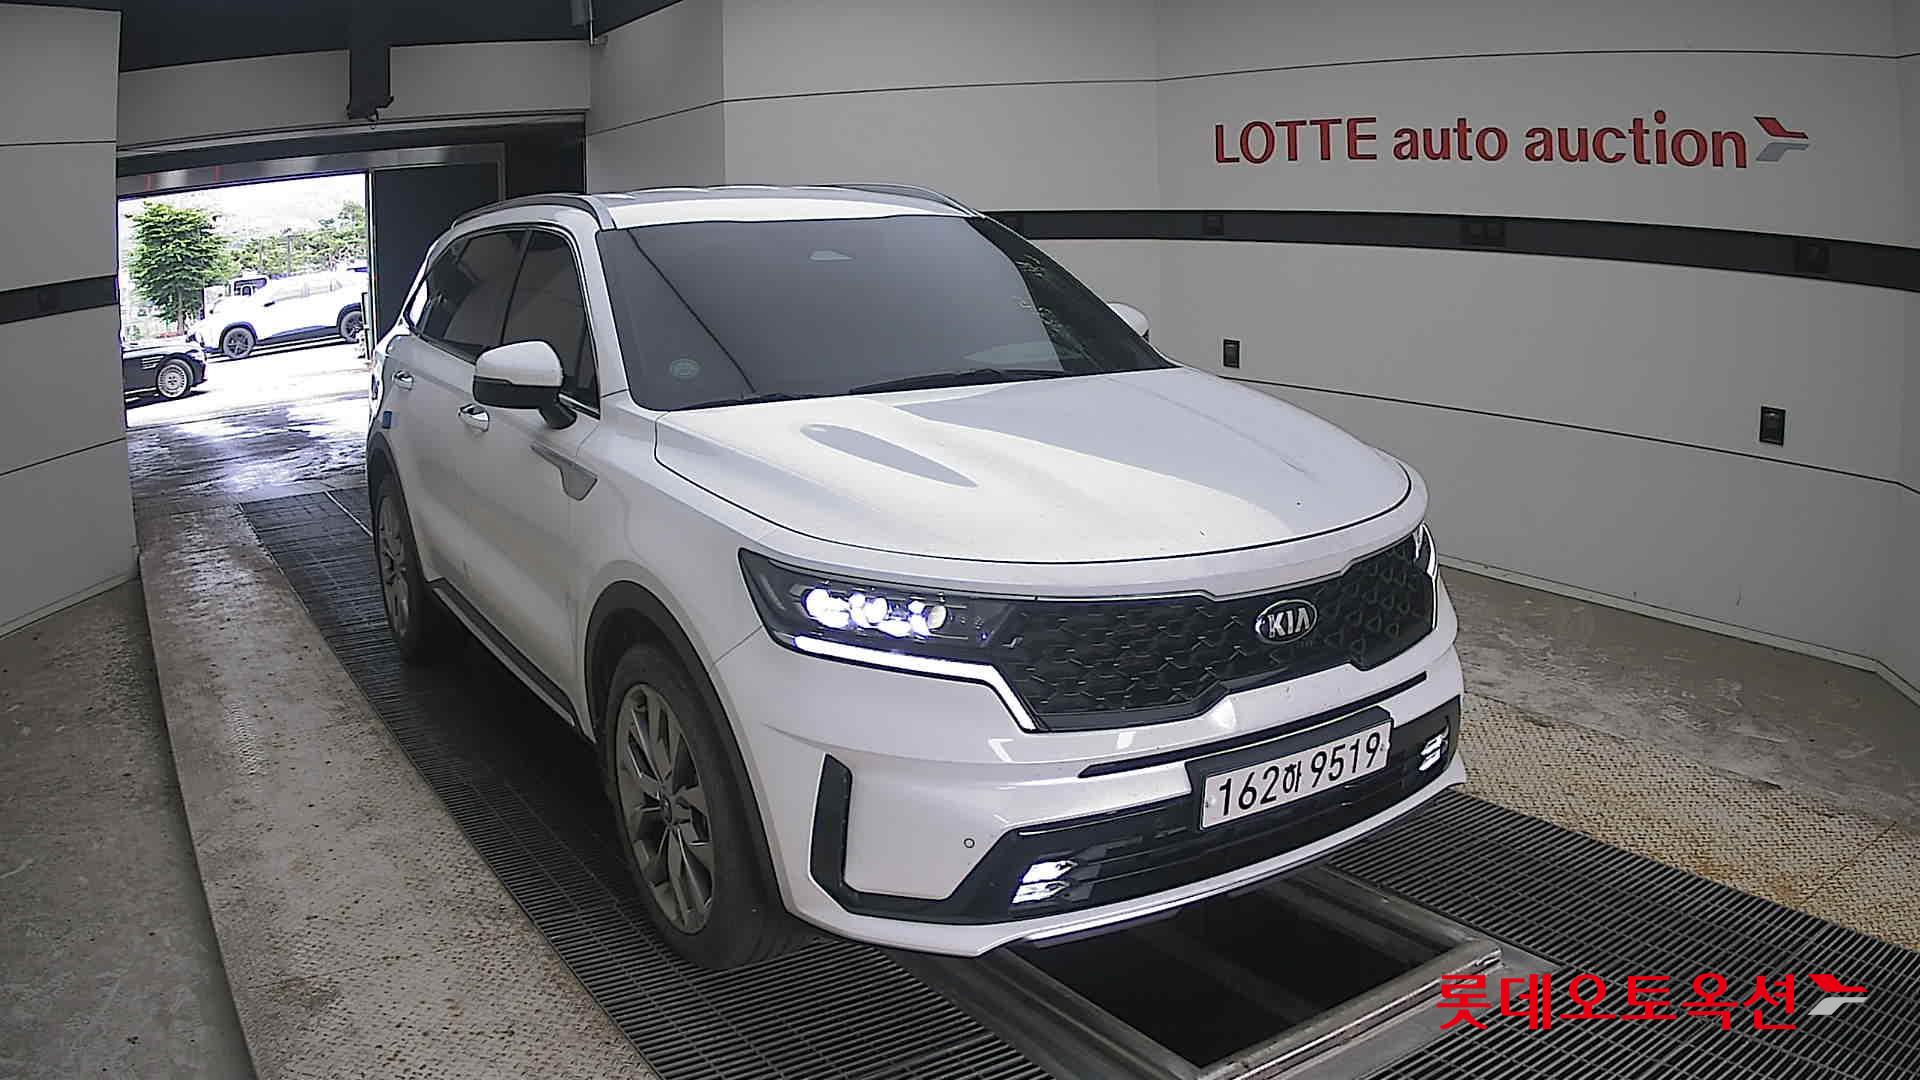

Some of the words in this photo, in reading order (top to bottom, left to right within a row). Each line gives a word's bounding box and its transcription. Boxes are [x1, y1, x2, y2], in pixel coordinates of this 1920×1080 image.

[1215, 116, 1378, 164] LOTTE
[1393, 117, 1509, 161] auto
[1524, 110, 1748, 168] auction
[1267, 607, 1310, 638] KIA
